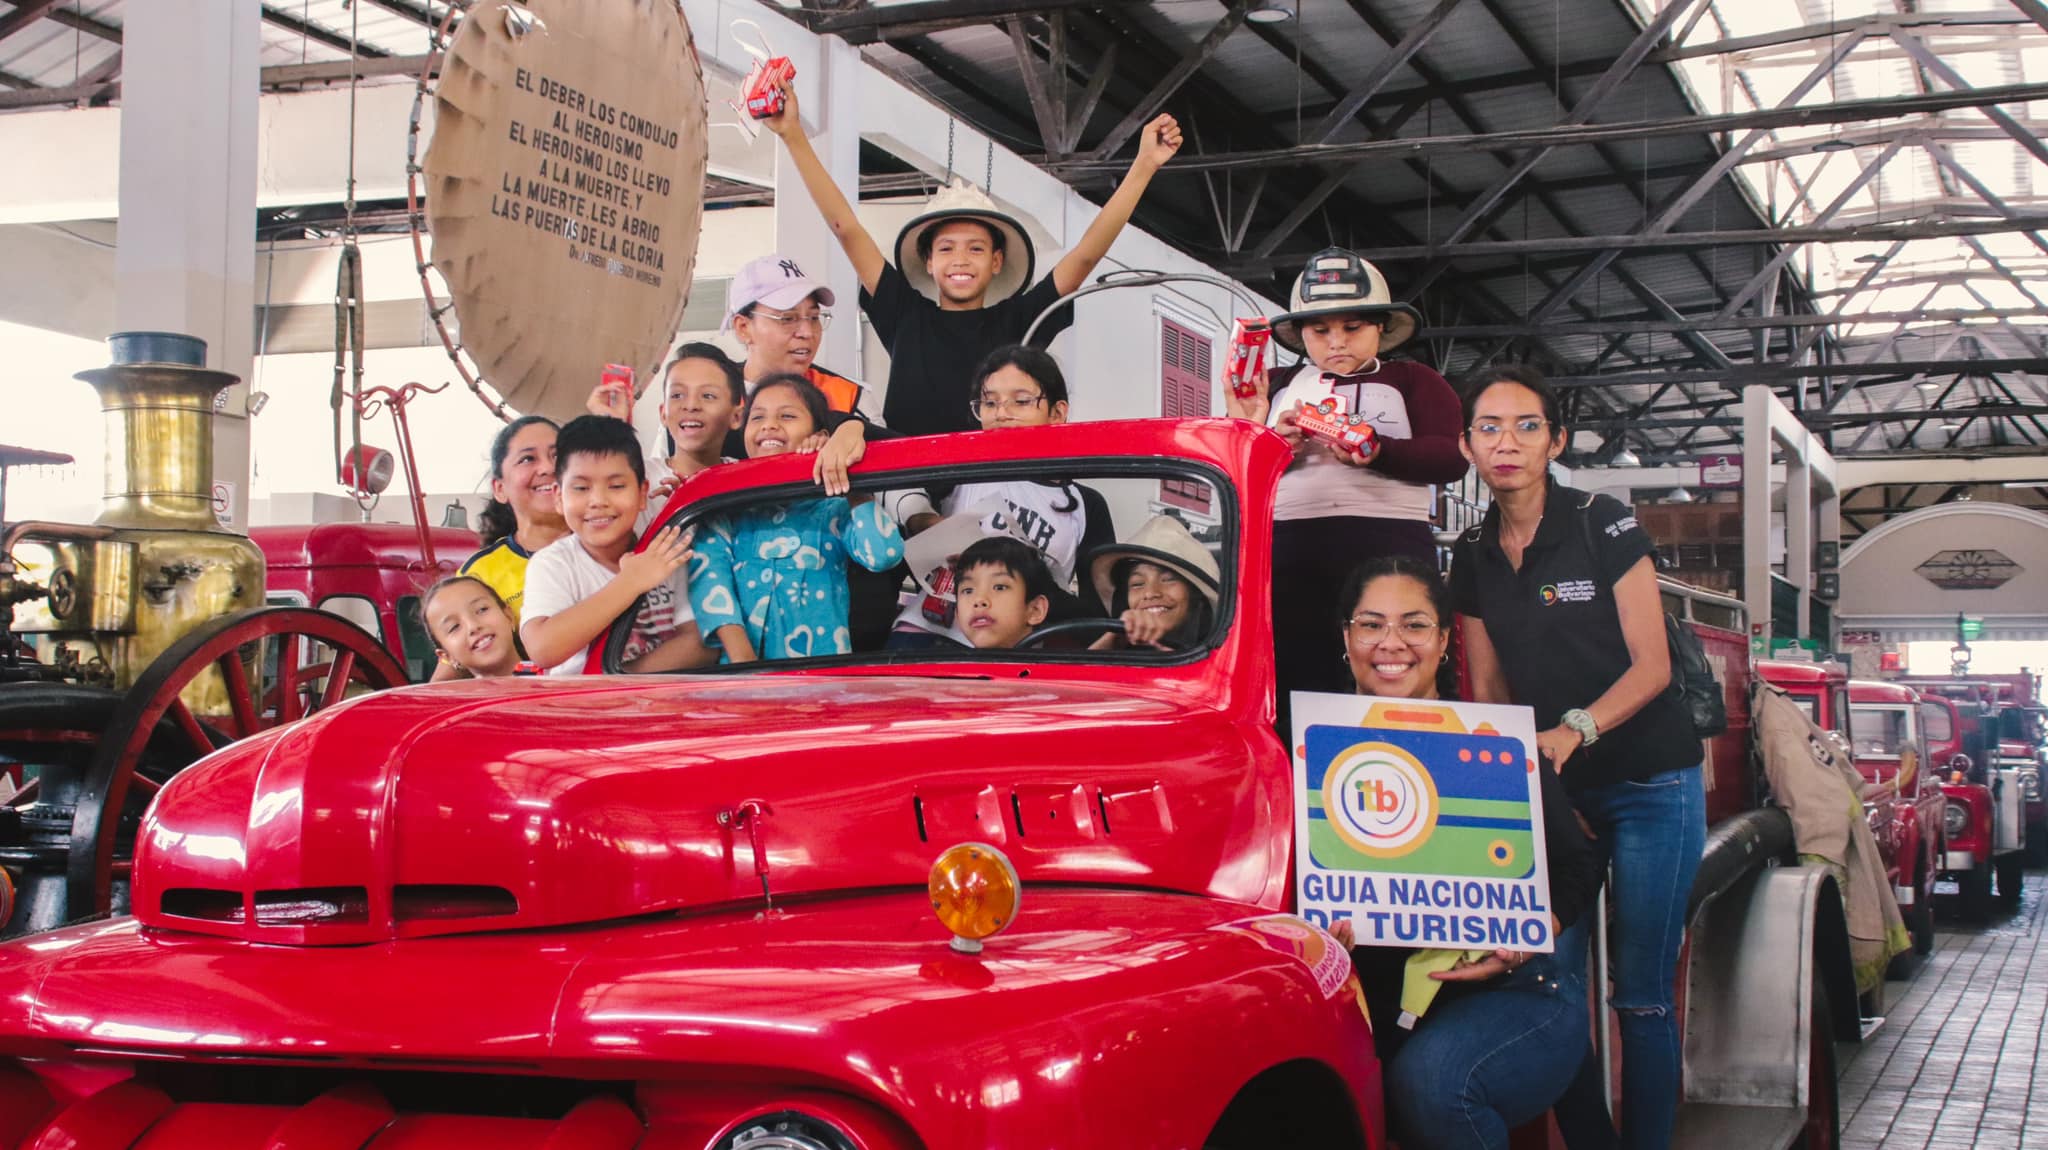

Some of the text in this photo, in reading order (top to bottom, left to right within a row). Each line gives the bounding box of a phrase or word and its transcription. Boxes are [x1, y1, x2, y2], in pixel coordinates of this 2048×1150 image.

[516, 68, 678, 149] EL DEBER LOS CONDUJO
[553, 110, 570, 134] AL
[509, 120, 670, 197] EL HEROISMO LOS LLEVO
[502, 171, 521, 196] LA
[591, 202, 617, 228] LES
[622, 214, 660, 243] ABRIO
[539, 159, 548, 178] A
[552, 162, 570, 186] LA
[636, 193, 643, 211] Y
[491, 194, 664, 271] LAS PUERTAS DE LA GLORIA
[1355, 779, 1399, 813] itb
[1303, 873, 1546, 912] GUIA NACIONAL
[1367, 911, 1547, 946] TURISMO
